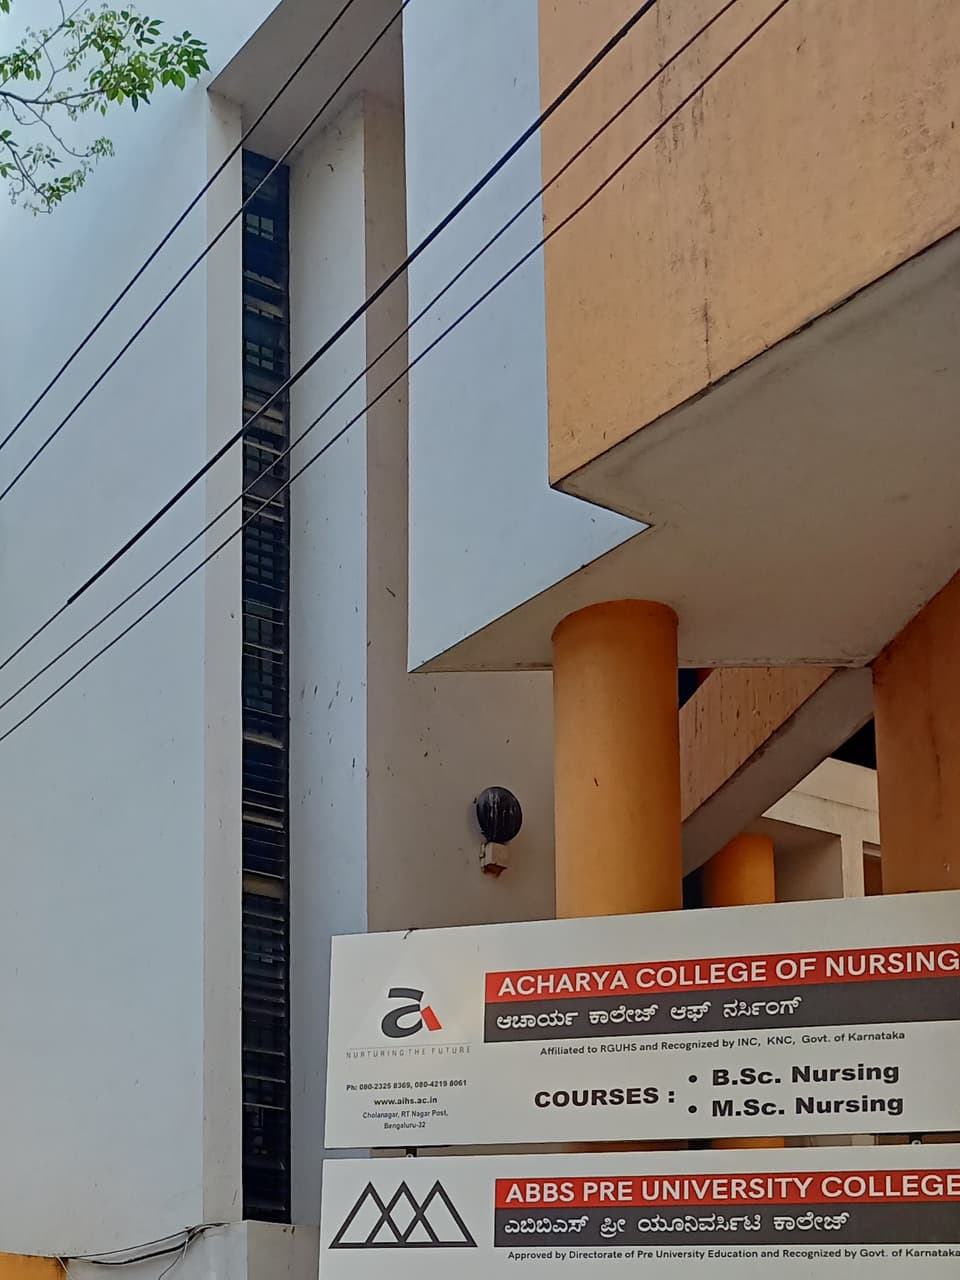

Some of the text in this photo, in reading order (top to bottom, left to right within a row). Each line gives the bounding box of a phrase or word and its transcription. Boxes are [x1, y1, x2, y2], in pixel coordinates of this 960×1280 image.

[498, 950, 960, 997] ACHARYA COLLEGE OF NURSING
[496, 996, 802, 1030] ಆಚಾರ್ಯ ಕಾಲೇಜ್ ಆಫ್ ನರ್ಸಿಂಗ್
[408, 1048, 426, 1056] THE
[432, 1046, 471, 1055] FUTURE
[540, 1031, 905, 1056] Affiliated to RGUHS and Recognized by INC, KNC, Govt. of Karnataka
[359, 1082, 392, 1091] 080-2325
[415, 1080, 448, 1089] 080-4219
[449, 1079, 467, 1087] 8061
[712, 1063, 899, 1086] B.Sc. Nursing
[534, 1087, 659, 1108] COURSES
[712, 1094, 904, 1117] M.Sc. Nursing
[401, 1110, 411, 1118] RT
[412, 1110, 430, 1119] Nagar
[505, 1174, 960, 1203] ABBS PRE UNIVERSITY COLLEGE
[773, 1211, 850, 1232] ಕಾಲೇಜ್
[508, 1248, 960, 1261] Approved by Directorate of Pre University Education and Recognized by Govt. of Karnataka
